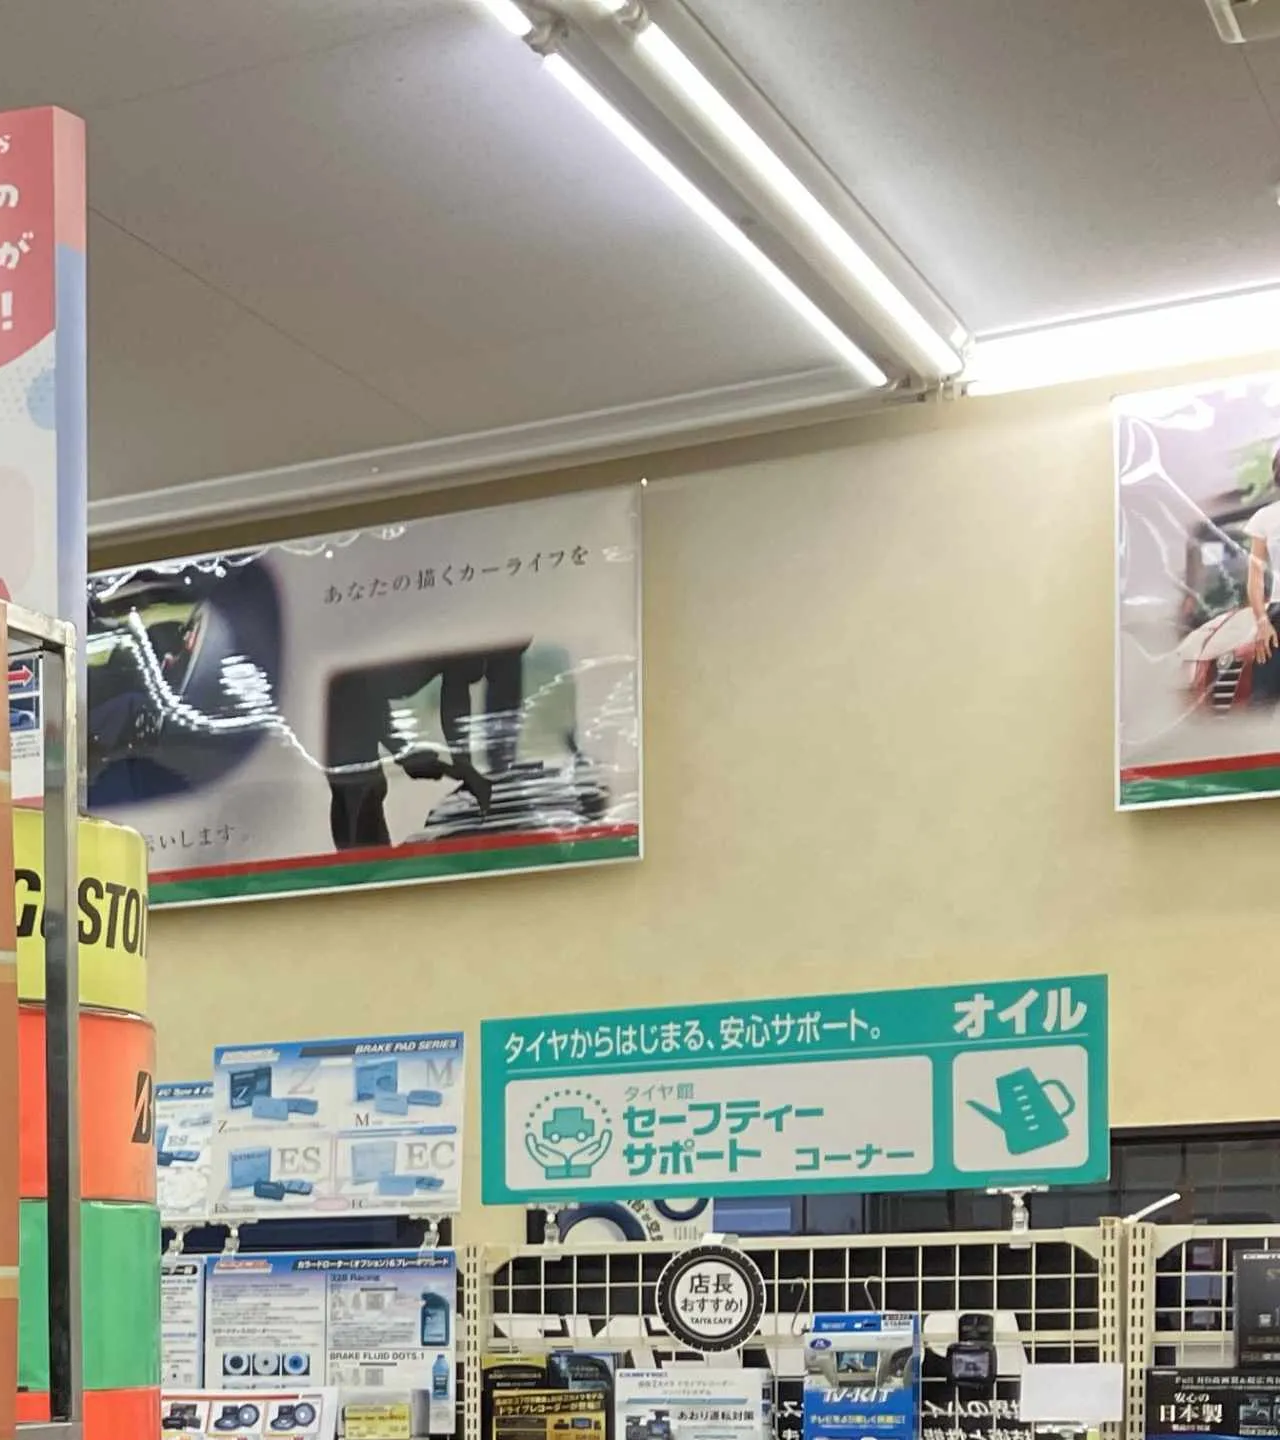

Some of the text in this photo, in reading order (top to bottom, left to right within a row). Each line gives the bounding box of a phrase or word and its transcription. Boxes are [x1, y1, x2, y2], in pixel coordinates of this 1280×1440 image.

[323, 544, 591, 606] あなたの描くカーライフを
[953, 986, 1088, 1039] オイル
[354, 1041, 393, 1056] BRAKE
[393, 1040, 417, 1053] PAD
[504, 1007, 883, 1064] タイヤからはじまる、安心サポート。
[623, 1081, 695, 1104] タイヤ館
[622, 1098, 826, 1138] セーフティー
[278, 1146, 322, 1175] ES
[404, 1140, 457, 1172] EC
[622, 1137, 916, 1176] サポート コーナー
[688, 1273, 734, 1295] 店長
[679, 1297, 744, 1314] おすすめ!
[329, 1351, 361, 1361] BRAKE
[362, 1351, 389, 1361] FLUID
[822, 1386, 896, 1403] TV-KIT
[1159, 1403, 1224, 1424] 日本製
